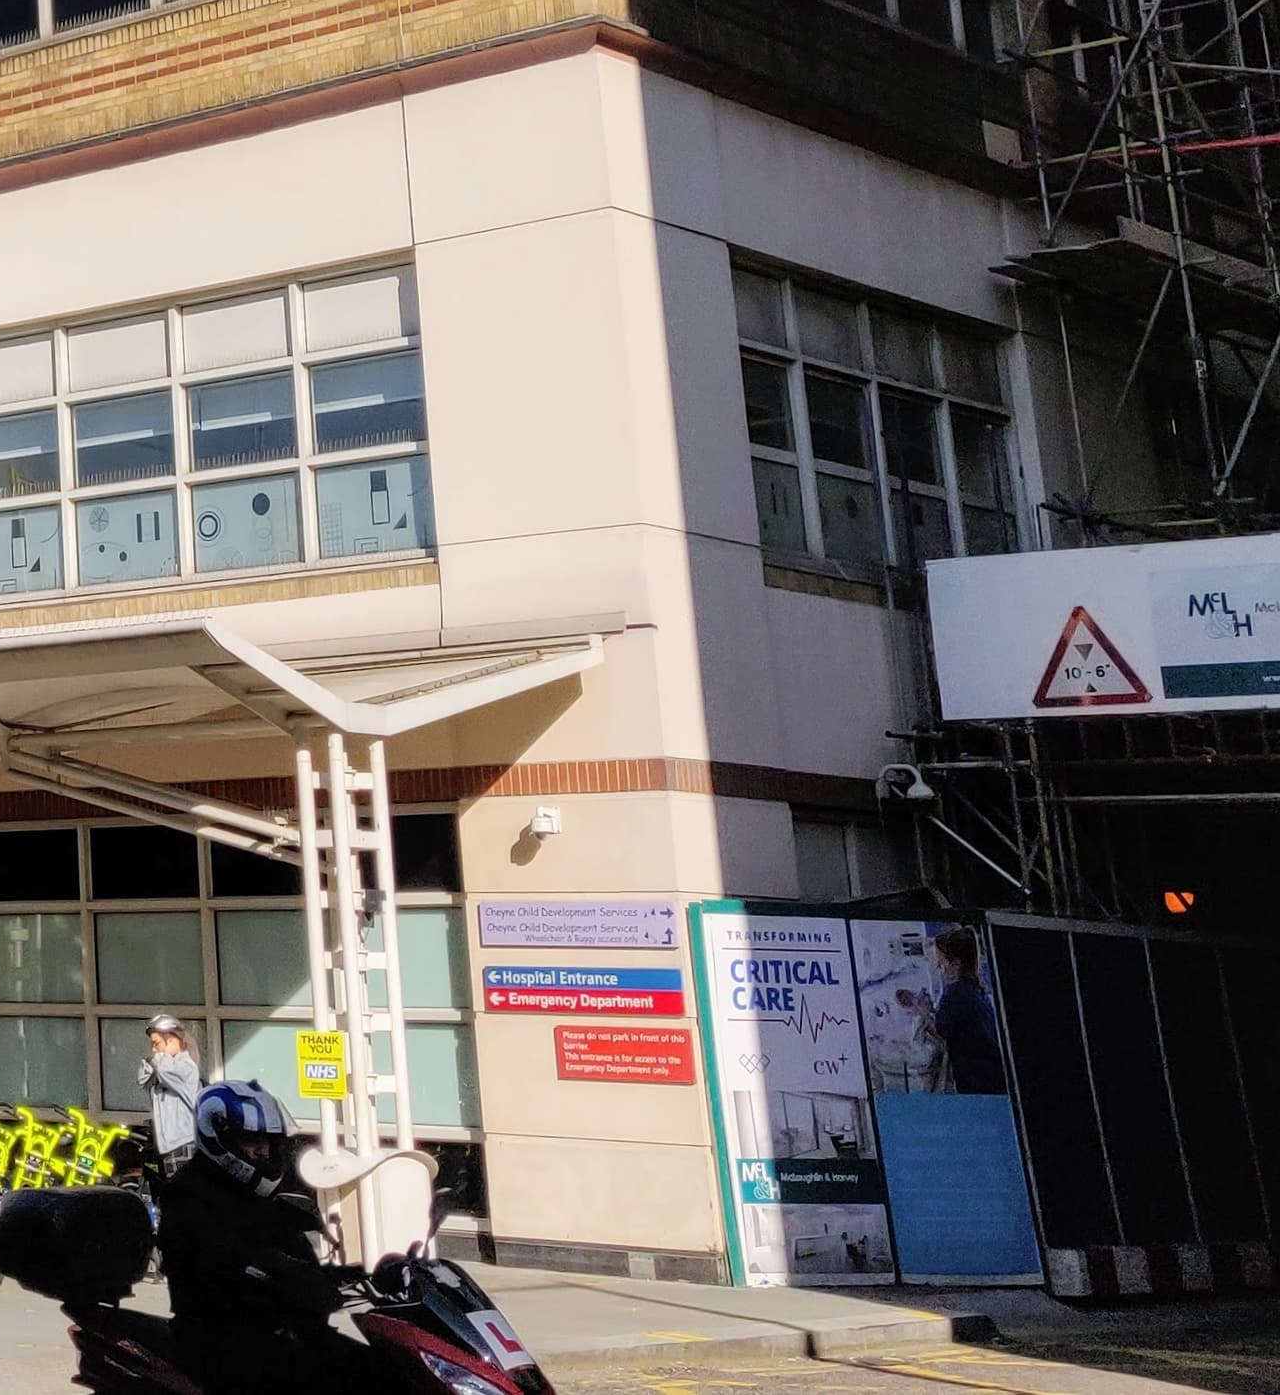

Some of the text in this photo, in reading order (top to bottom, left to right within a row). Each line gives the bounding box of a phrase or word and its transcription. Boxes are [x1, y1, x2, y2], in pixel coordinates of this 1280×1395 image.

[485, 906, 638, 919] Cheyne Child Development Services
[486, 922, 638, 935] Cheyne Child Development Services
[726, 930, 832, 943] TRANSFORMING
[503, 970, 618, 987] Hospital Entrance
[730, 959, 840, 985] CRITICAL
[509, 992, 654, 1010] Emergency Department
[732, 987, 795, 1011] CARE
[301, 1035, 339, 1045] THANK
[562, 1031, 685, 1043] Please do not park in front of this
[310, 1045, 332, 1054] YOU
[565, 1052, 681, 1064] This entrance is for access to the
[306, 1065, 337, 1079] NHS
[565, 1063, 671, 1077] Emergency Department only.
[485, 1321, 523, 1353] L
